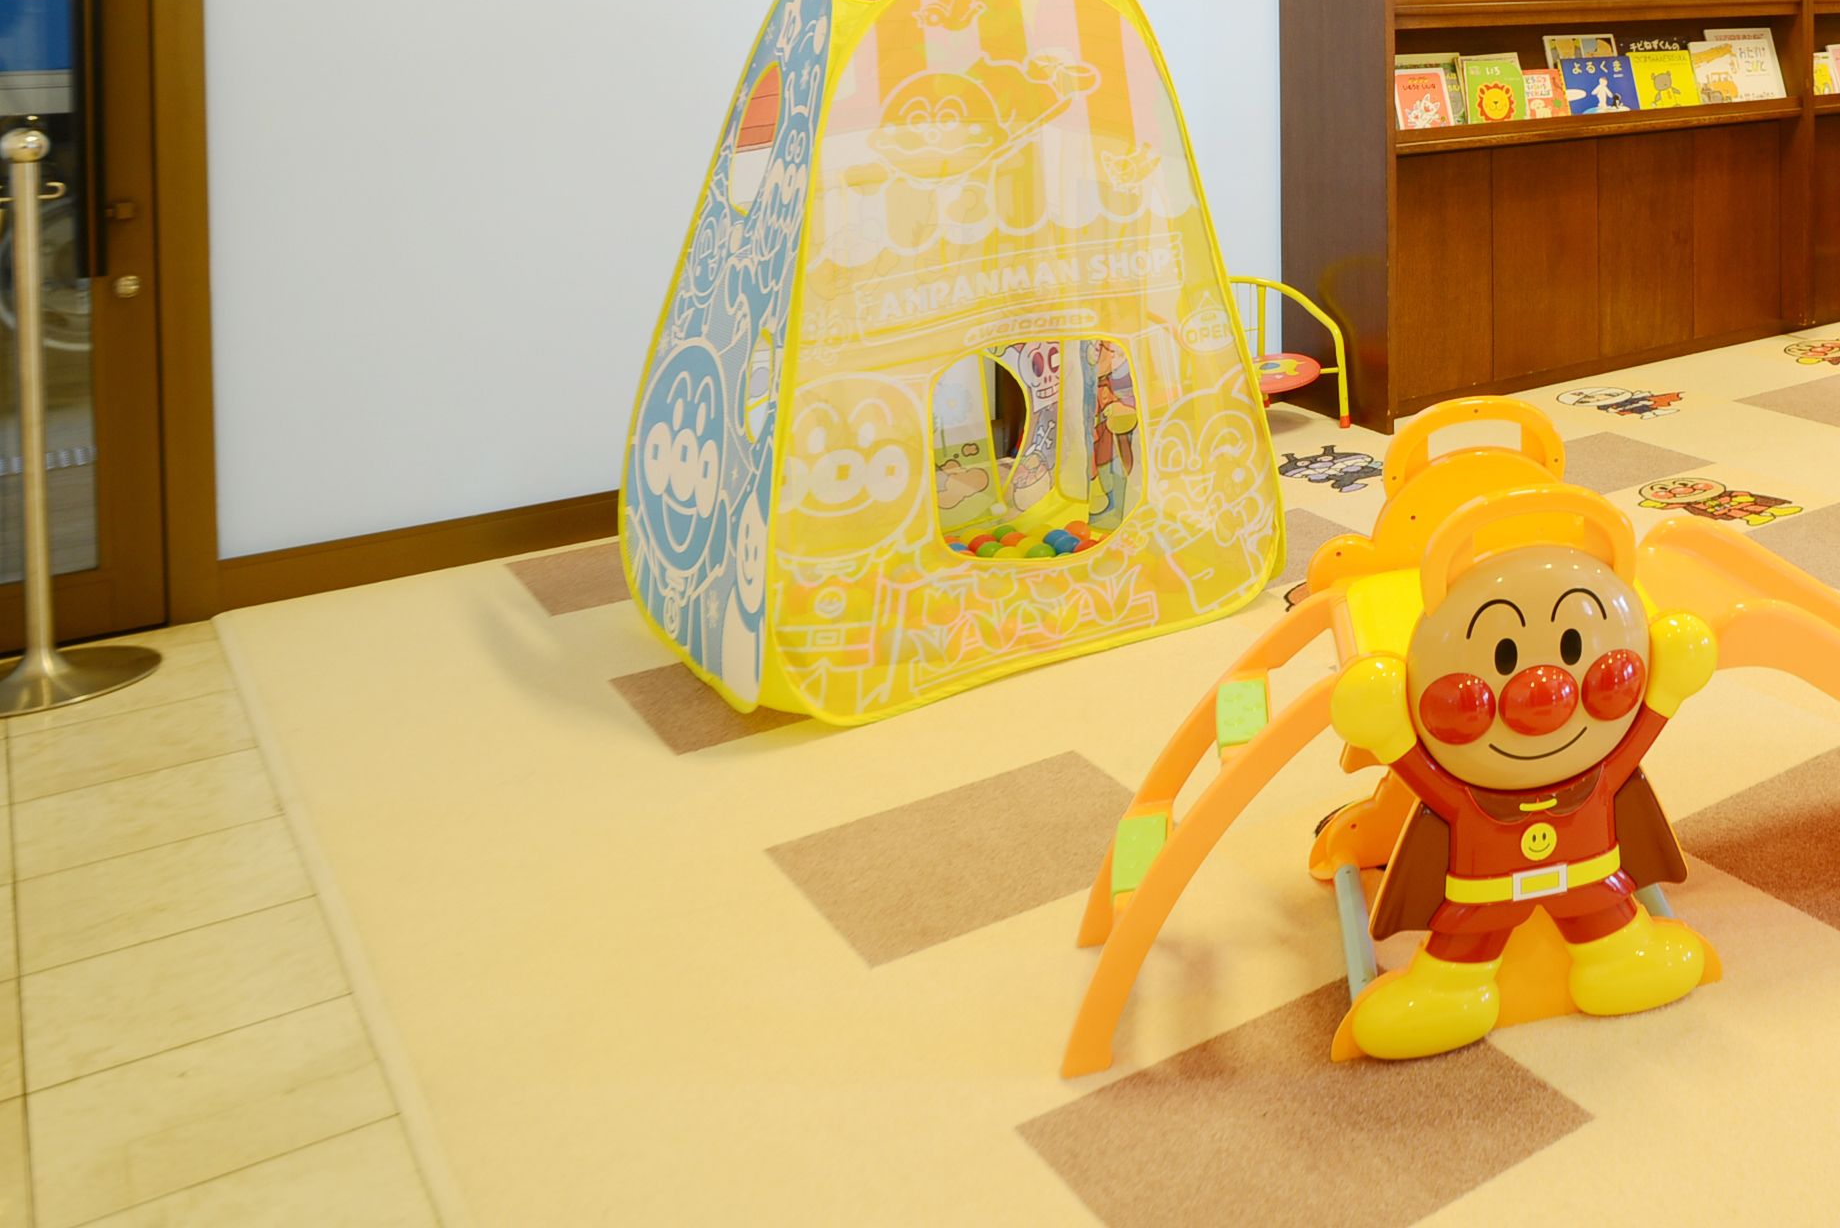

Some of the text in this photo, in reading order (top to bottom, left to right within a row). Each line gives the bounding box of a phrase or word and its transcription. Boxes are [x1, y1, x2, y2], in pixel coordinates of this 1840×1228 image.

[1572, 59, 1623, 75] よるくま
[879, 247, 1172, 319] ANPANMAN SHOP
